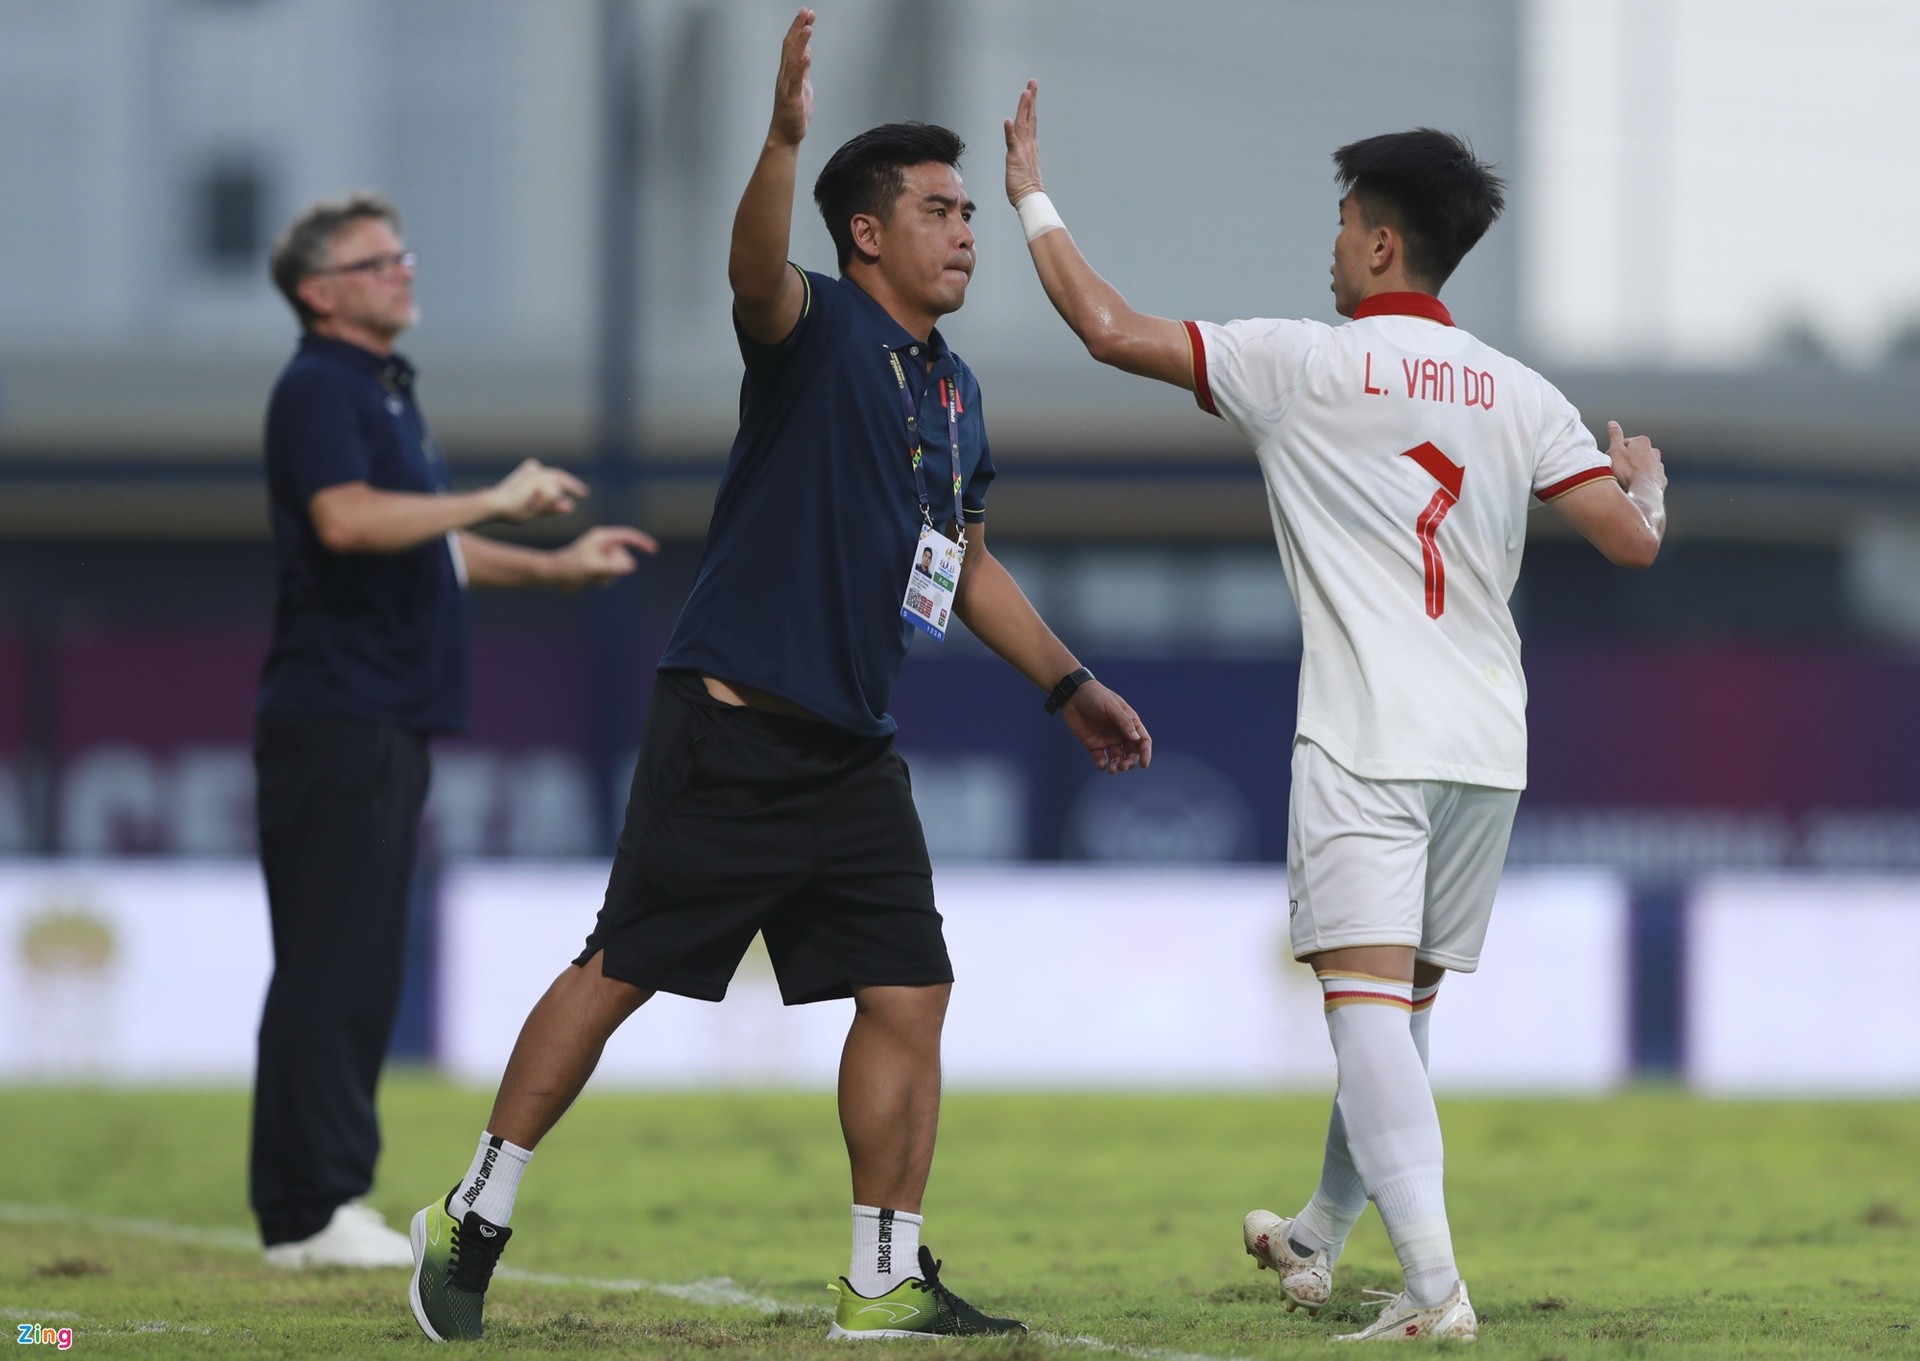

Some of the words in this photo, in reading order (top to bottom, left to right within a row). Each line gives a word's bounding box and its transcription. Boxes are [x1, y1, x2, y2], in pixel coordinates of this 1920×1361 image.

[1364, 351, 1389, 396] L.
[1402, 358, 1454, 403] VAN
[1463, 365, 1494, 411] DO
[1399, 440, 1466, 620] 7
[479, 1148, 498, 1180] GRAND
[462, 1176, 486, 1208] SPORT
[879, 1217, 893, 1243] RAND
[877, 1244, 892, 1275] SPORT
